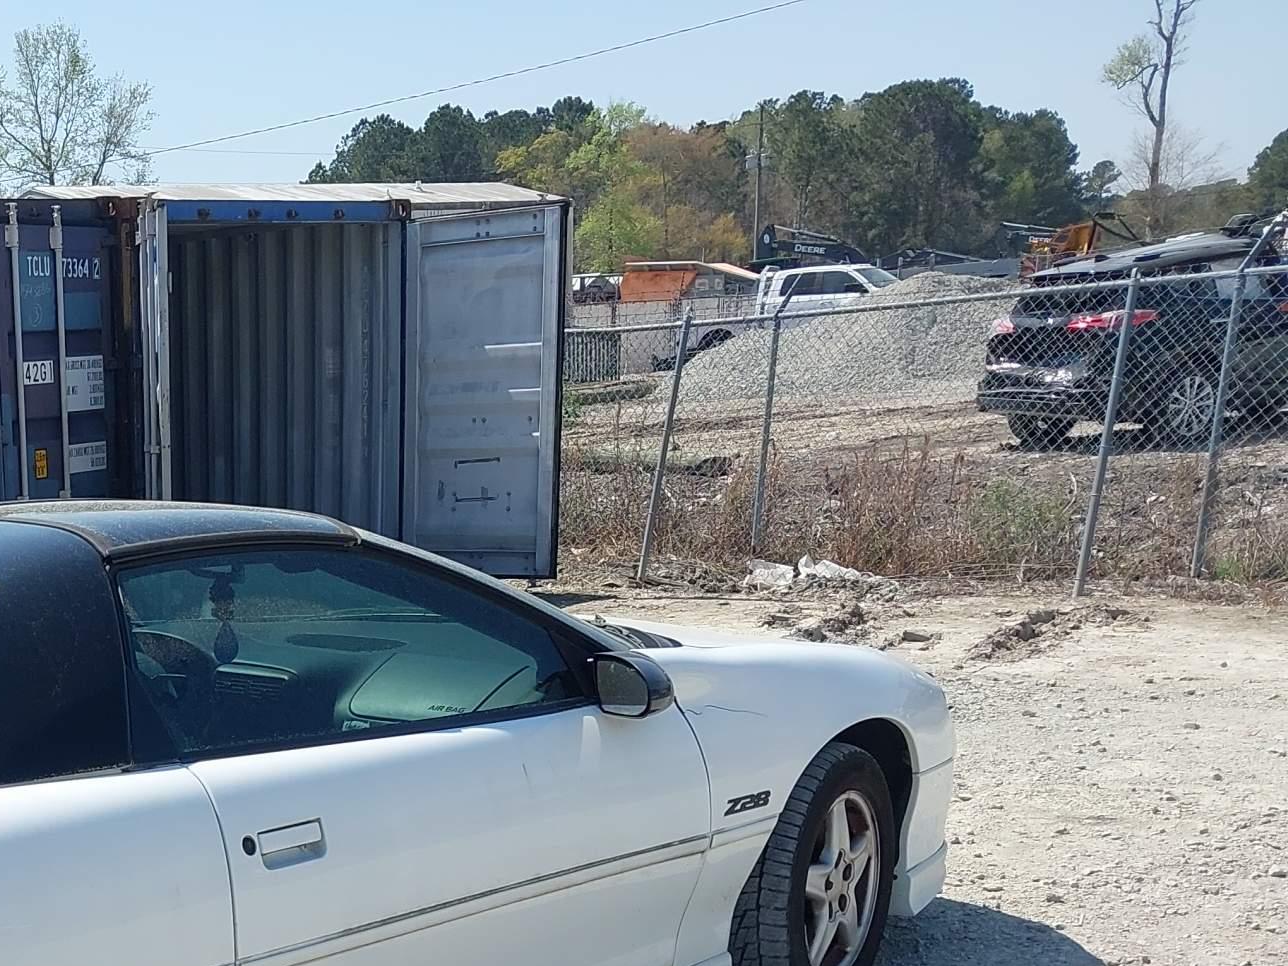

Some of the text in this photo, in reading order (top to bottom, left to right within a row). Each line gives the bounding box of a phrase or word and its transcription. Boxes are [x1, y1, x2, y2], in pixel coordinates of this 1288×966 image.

[794, 244, 826, 254] DEERE
[27, 256, 50, 276] TCLU
[25, 362, 53, 383] 42G1
[724, 790, 771, 817] Z28
